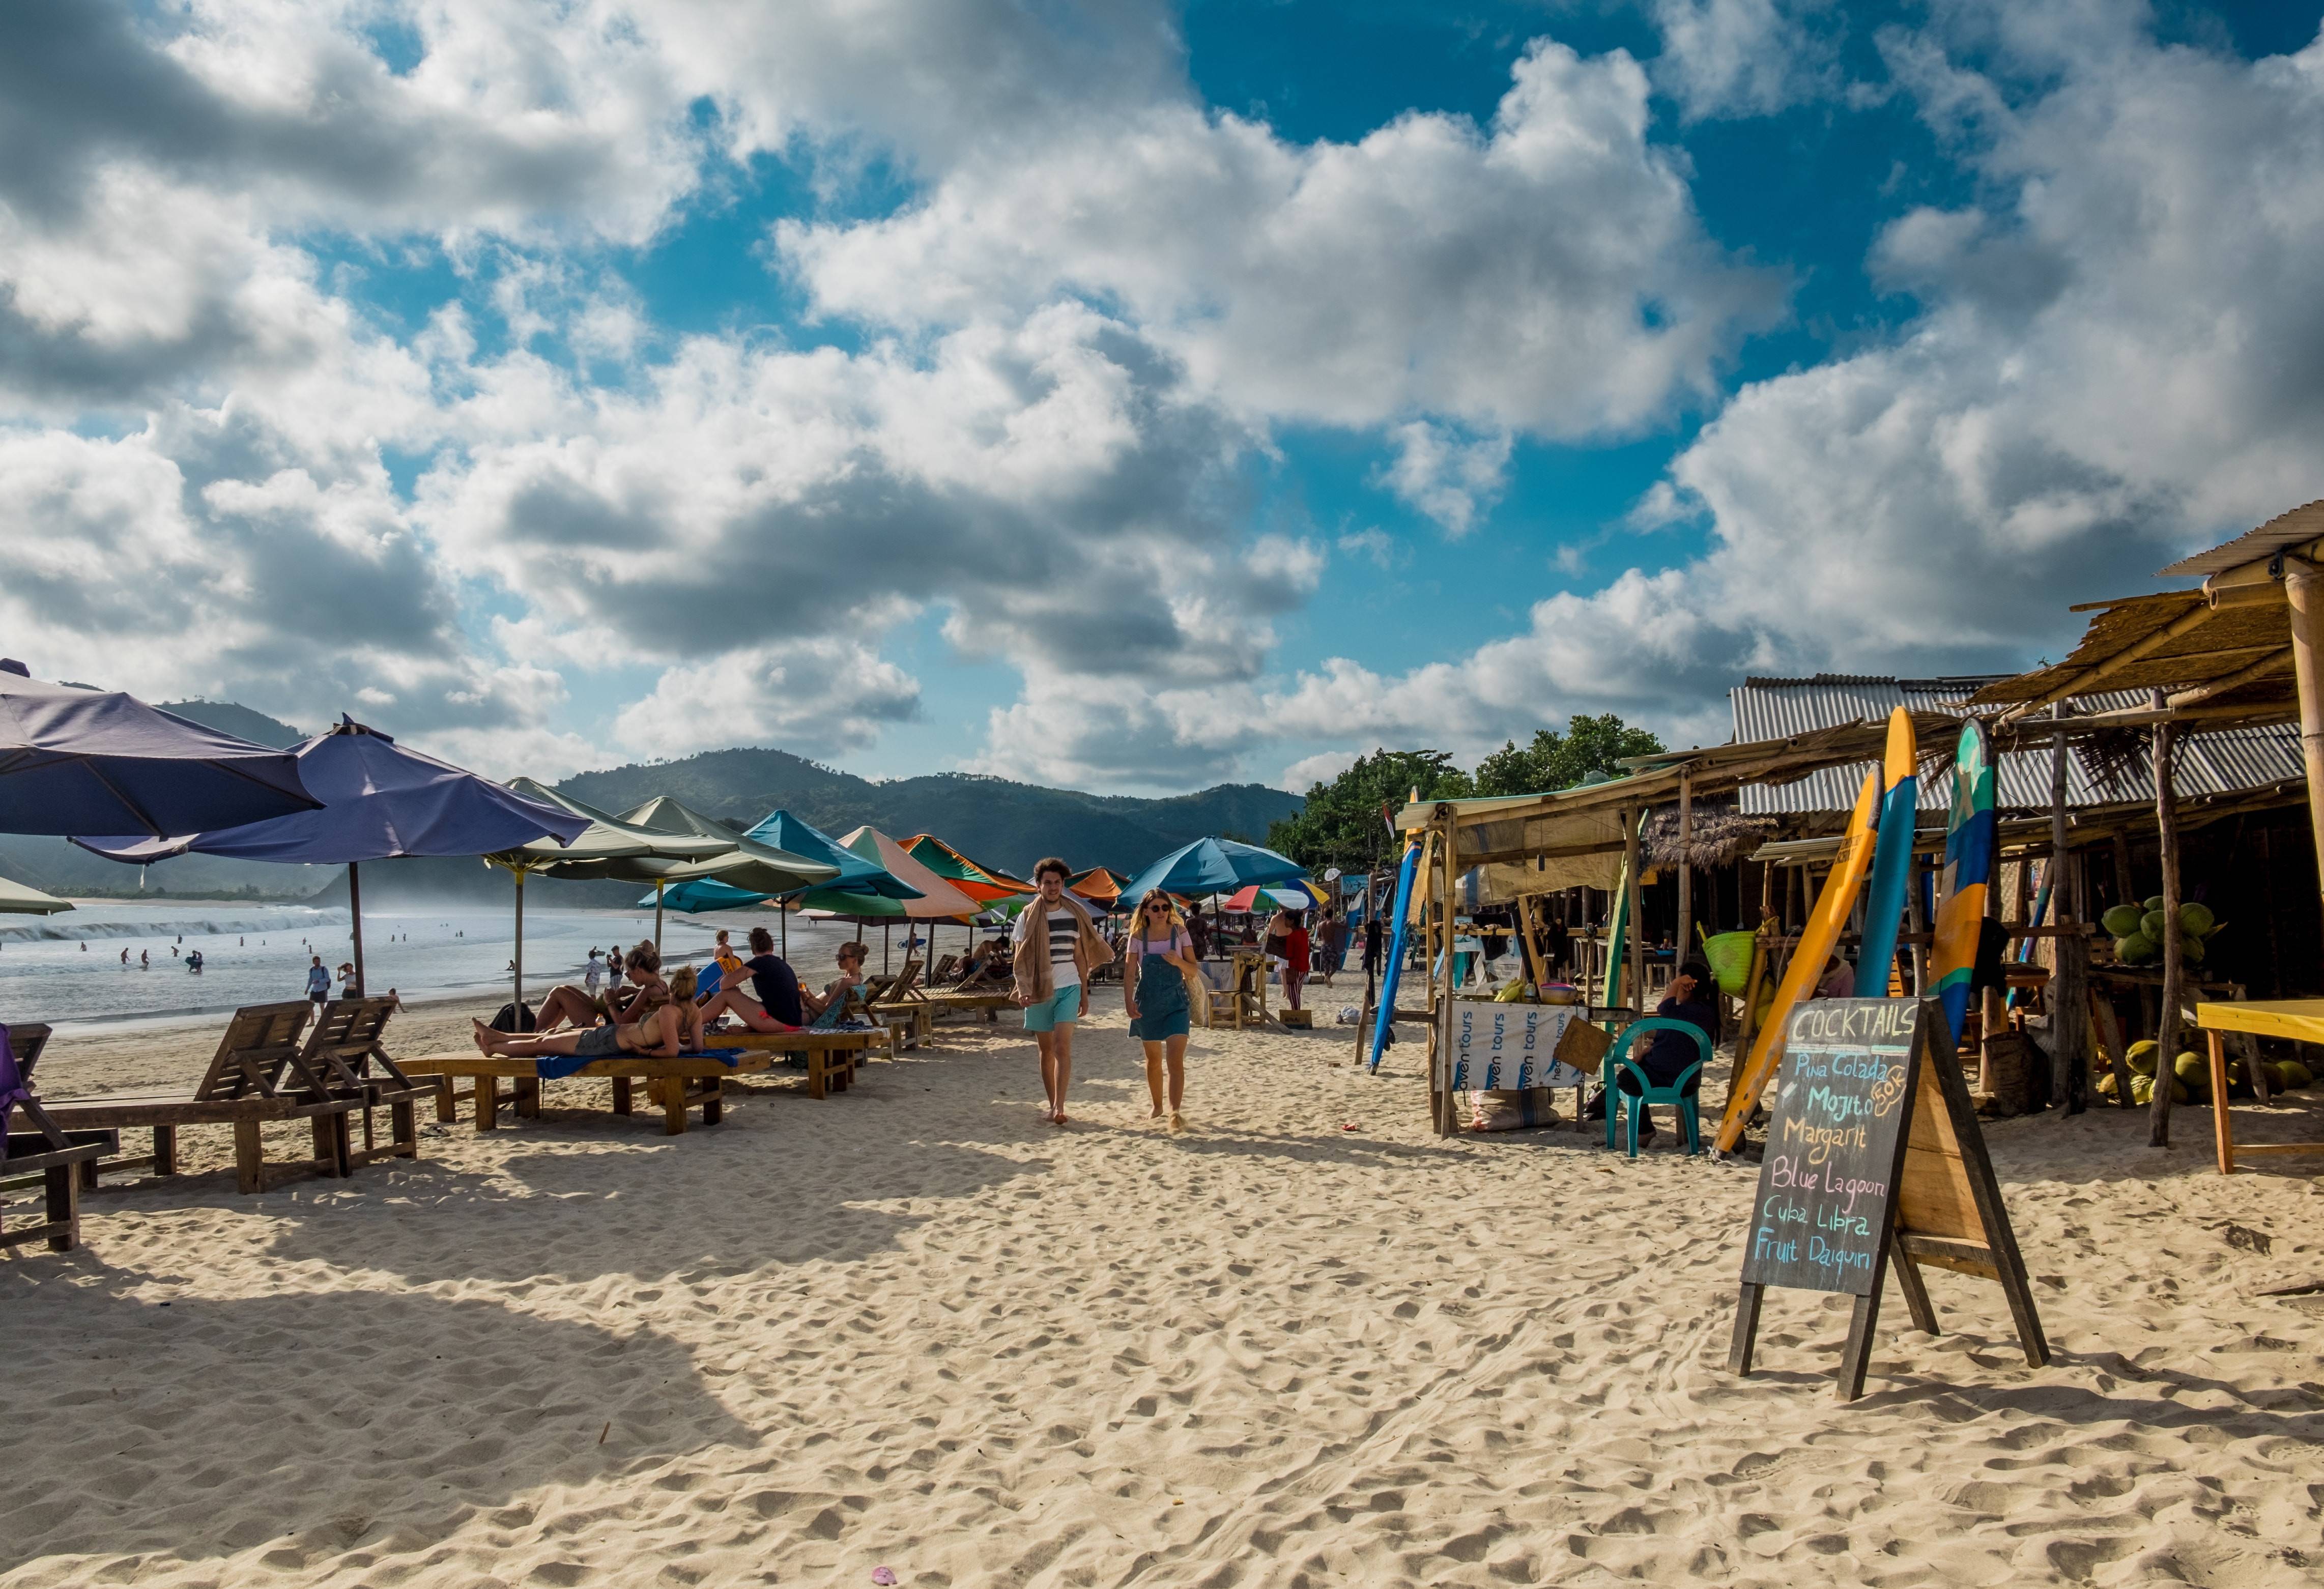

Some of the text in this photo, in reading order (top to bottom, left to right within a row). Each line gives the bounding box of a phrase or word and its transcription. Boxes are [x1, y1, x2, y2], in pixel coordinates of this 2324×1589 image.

[1459, 1011, 1473, 1048] tours
[1491, 1013, 1505, 1050] tours
[1523, 1012, 1537, 1050] tours
[1556, 1013, 1565, 1038] tours
[1792, 1004, 1919, 1042] COCKTAILS
[1831, 1052, 1888, 1082] Colada
[1807, 1085, 1874, 1122] Mojito
[1875, 1071, 1906, 1106] 50K
[1783, 1116, 1867, 1165] Margarit
[1771, 1155, 1885, 1215] Blue Lagoon
[1763, 1195, 1871, 1236] Cuba Libra
[1755, 1226, 1870, 1275] Fruit Daiquiri
